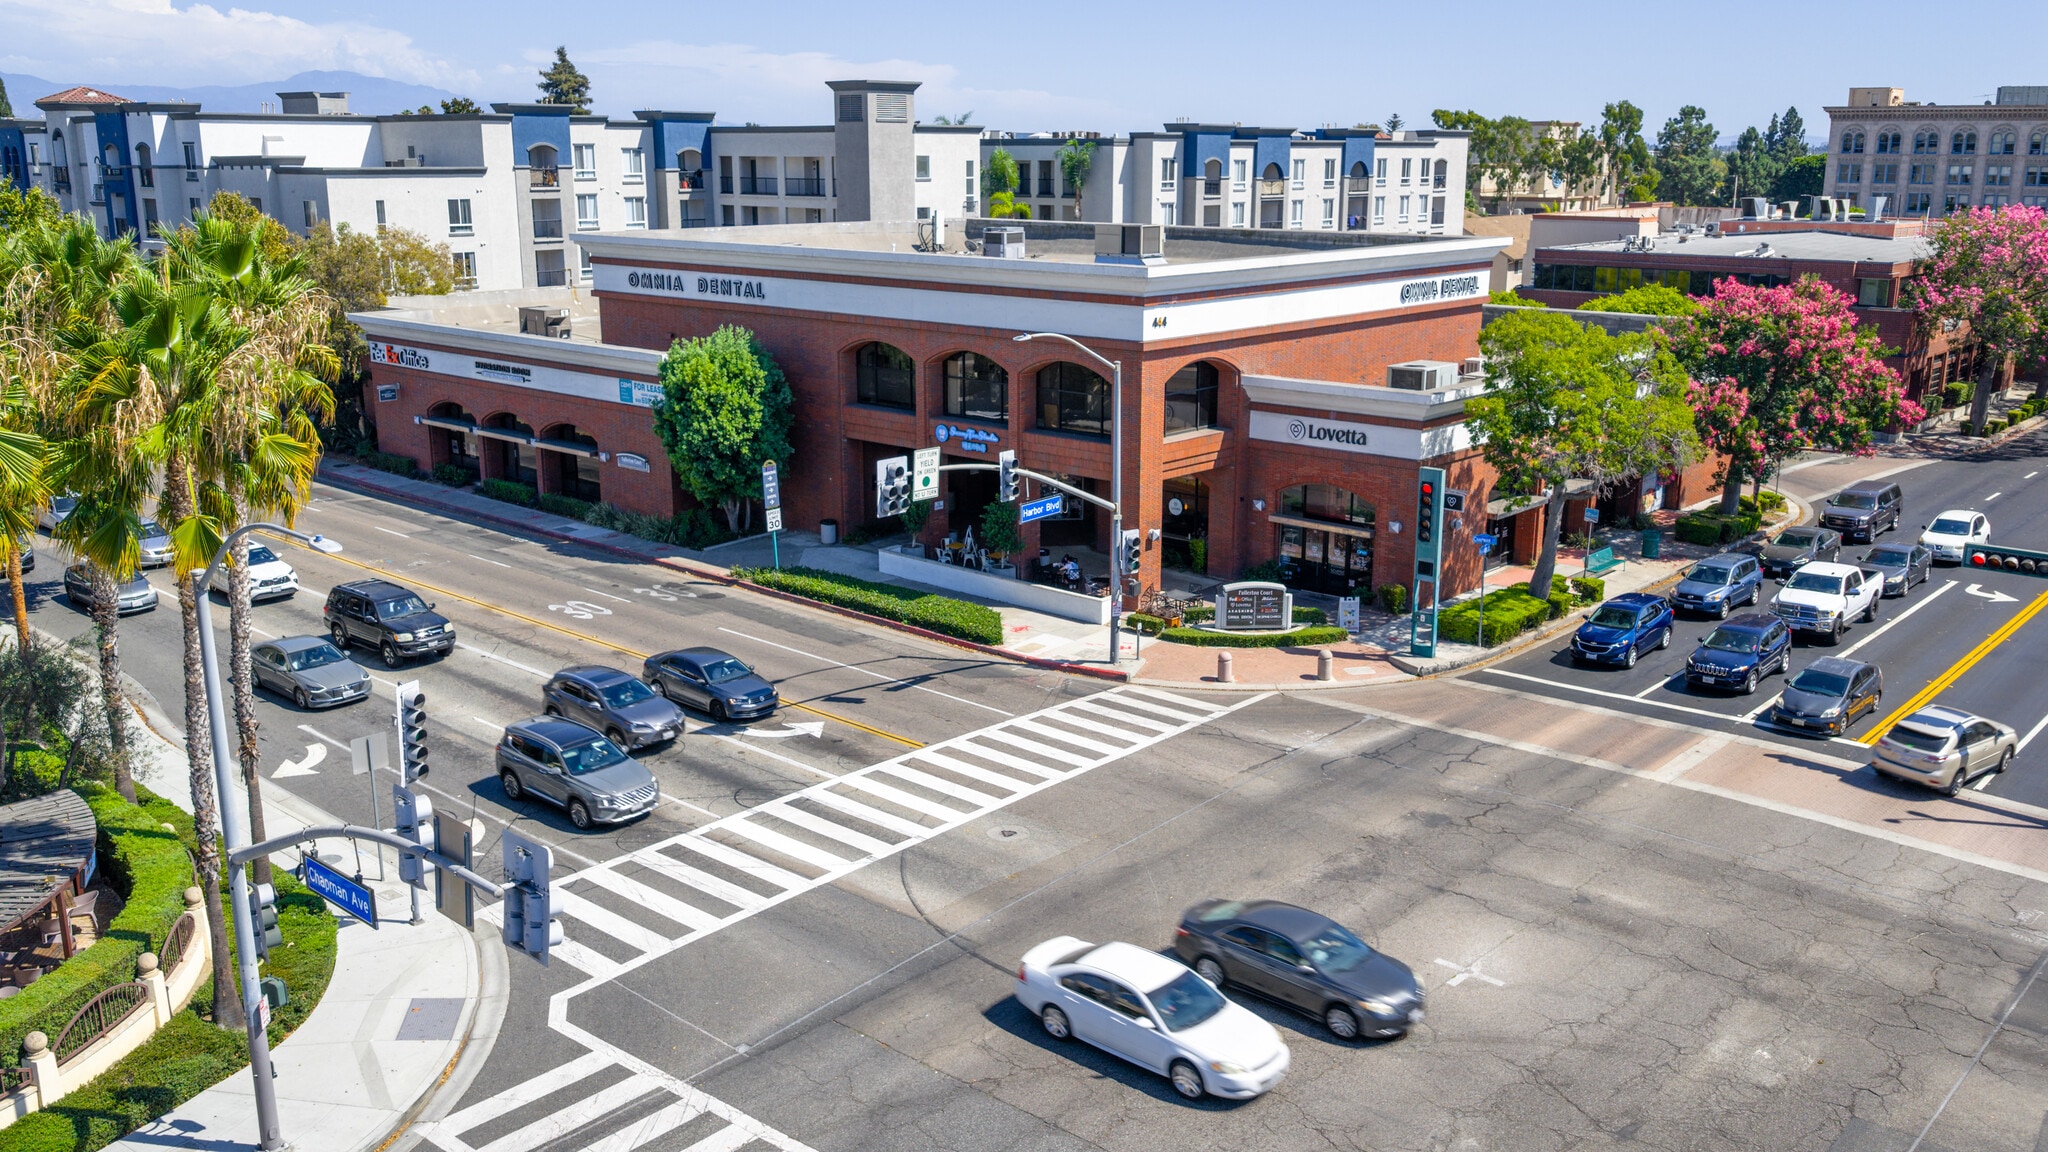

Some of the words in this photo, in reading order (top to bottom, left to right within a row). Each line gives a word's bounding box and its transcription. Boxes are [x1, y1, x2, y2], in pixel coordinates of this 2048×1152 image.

[628, 271, 684, 292] OMNIA
[697, 277, 766, 299] DENTAL
[1400, 281, 1438, 302] OMNIA
[1441, 276, 1480, 297] DENTAL
[371, 343, 400, 364] FedEx
[633, 382, 646, 392] FOR
[1308, 424, 1367, 446] Lovetta
[920, 459, 934, 467] YIELD
[1023, 506, 1044, 518] Harbor
[1045, 500, 1060, 511] Blvd
[769, 519, 780, 529] 30
[548, 600, 613, 619] 30
[308, 866, 348, 902] Chapman
[351, 891, 369, 914] Ave
